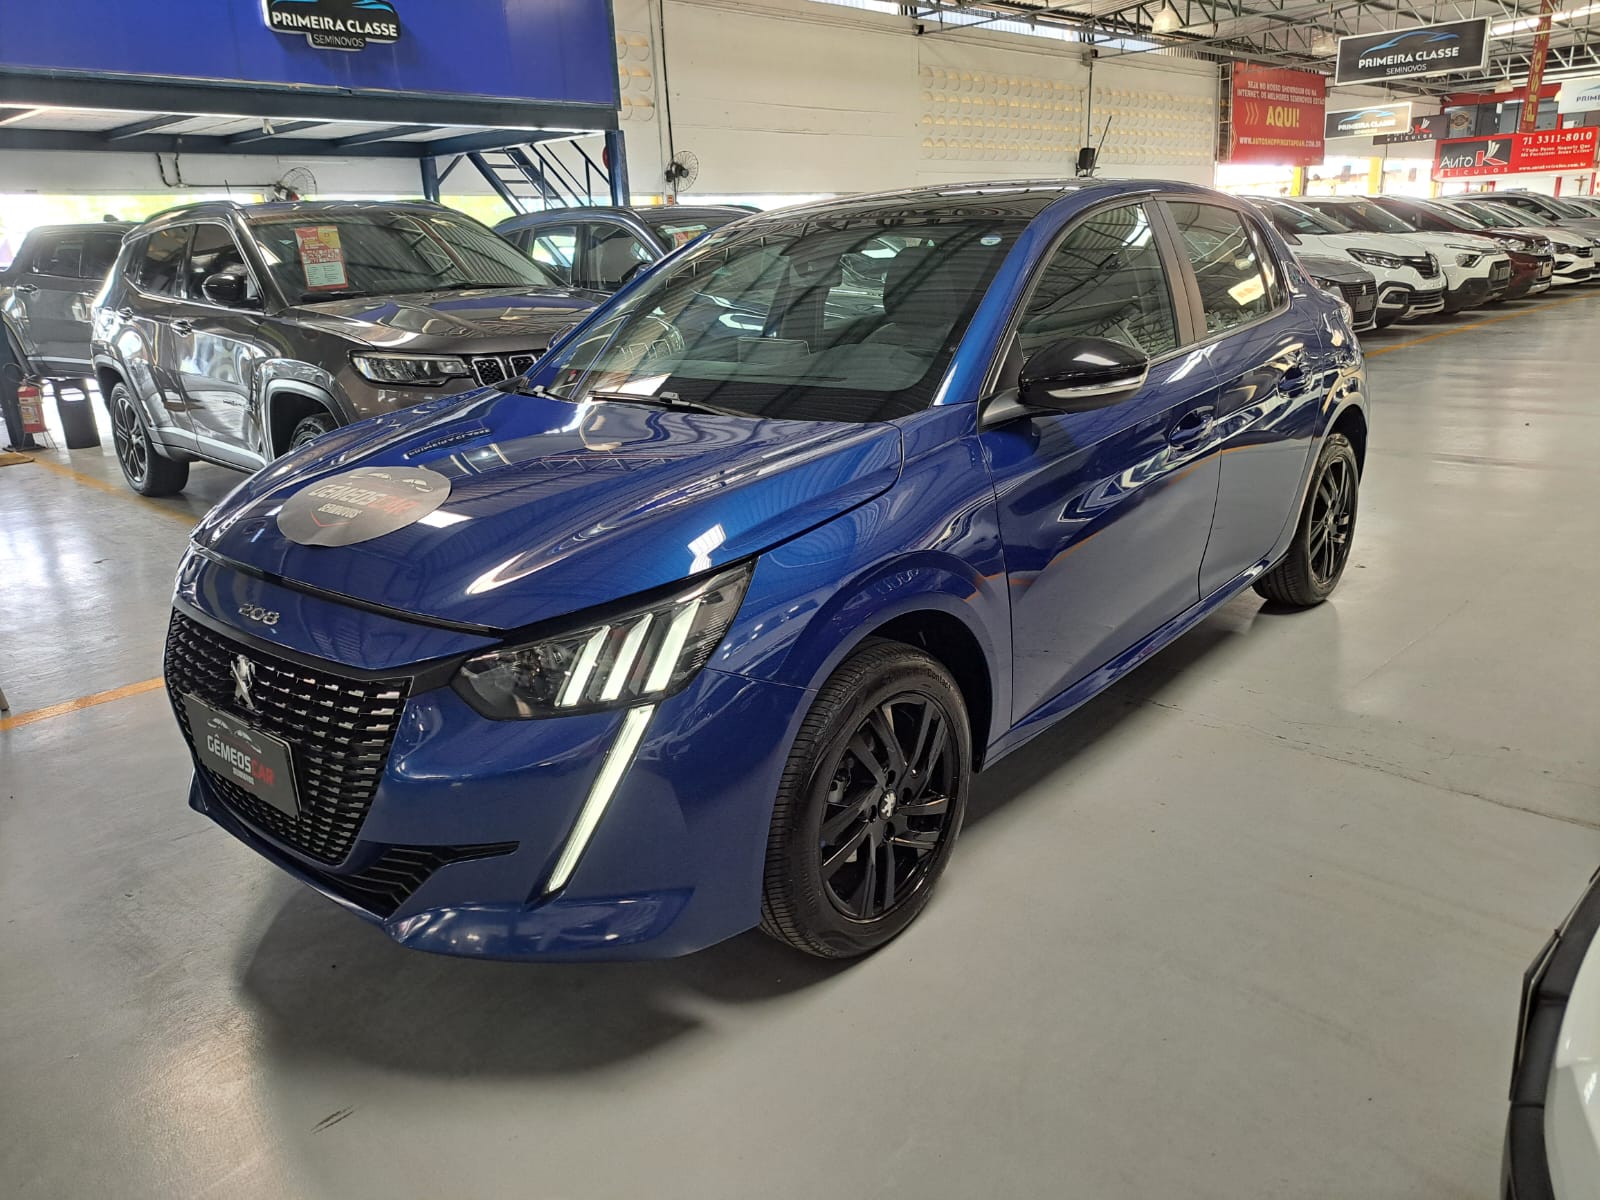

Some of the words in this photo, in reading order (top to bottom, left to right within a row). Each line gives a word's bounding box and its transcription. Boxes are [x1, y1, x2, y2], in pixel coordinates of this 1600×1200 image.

[271, 11, 346, 32] PRIMEIRA
[346, 19, 398, 37] CLASSE
[313, 33, 365, 48] SEMINOVOS
[1358, 53, 1414, 69] PRIMEIRA
[1415, 46, 1460, 61] CLASSE
[1386, 63, 1427, 75] SEMINOVOS
[1266, 105, 1300, 128] AQUI!
[1523, 137, 1532, 145] 71
[1537, 132, 1592, 144] 3311-8010
[1440, 155, 1473, 169] Auto
[238, 603, 280, 625] 208
